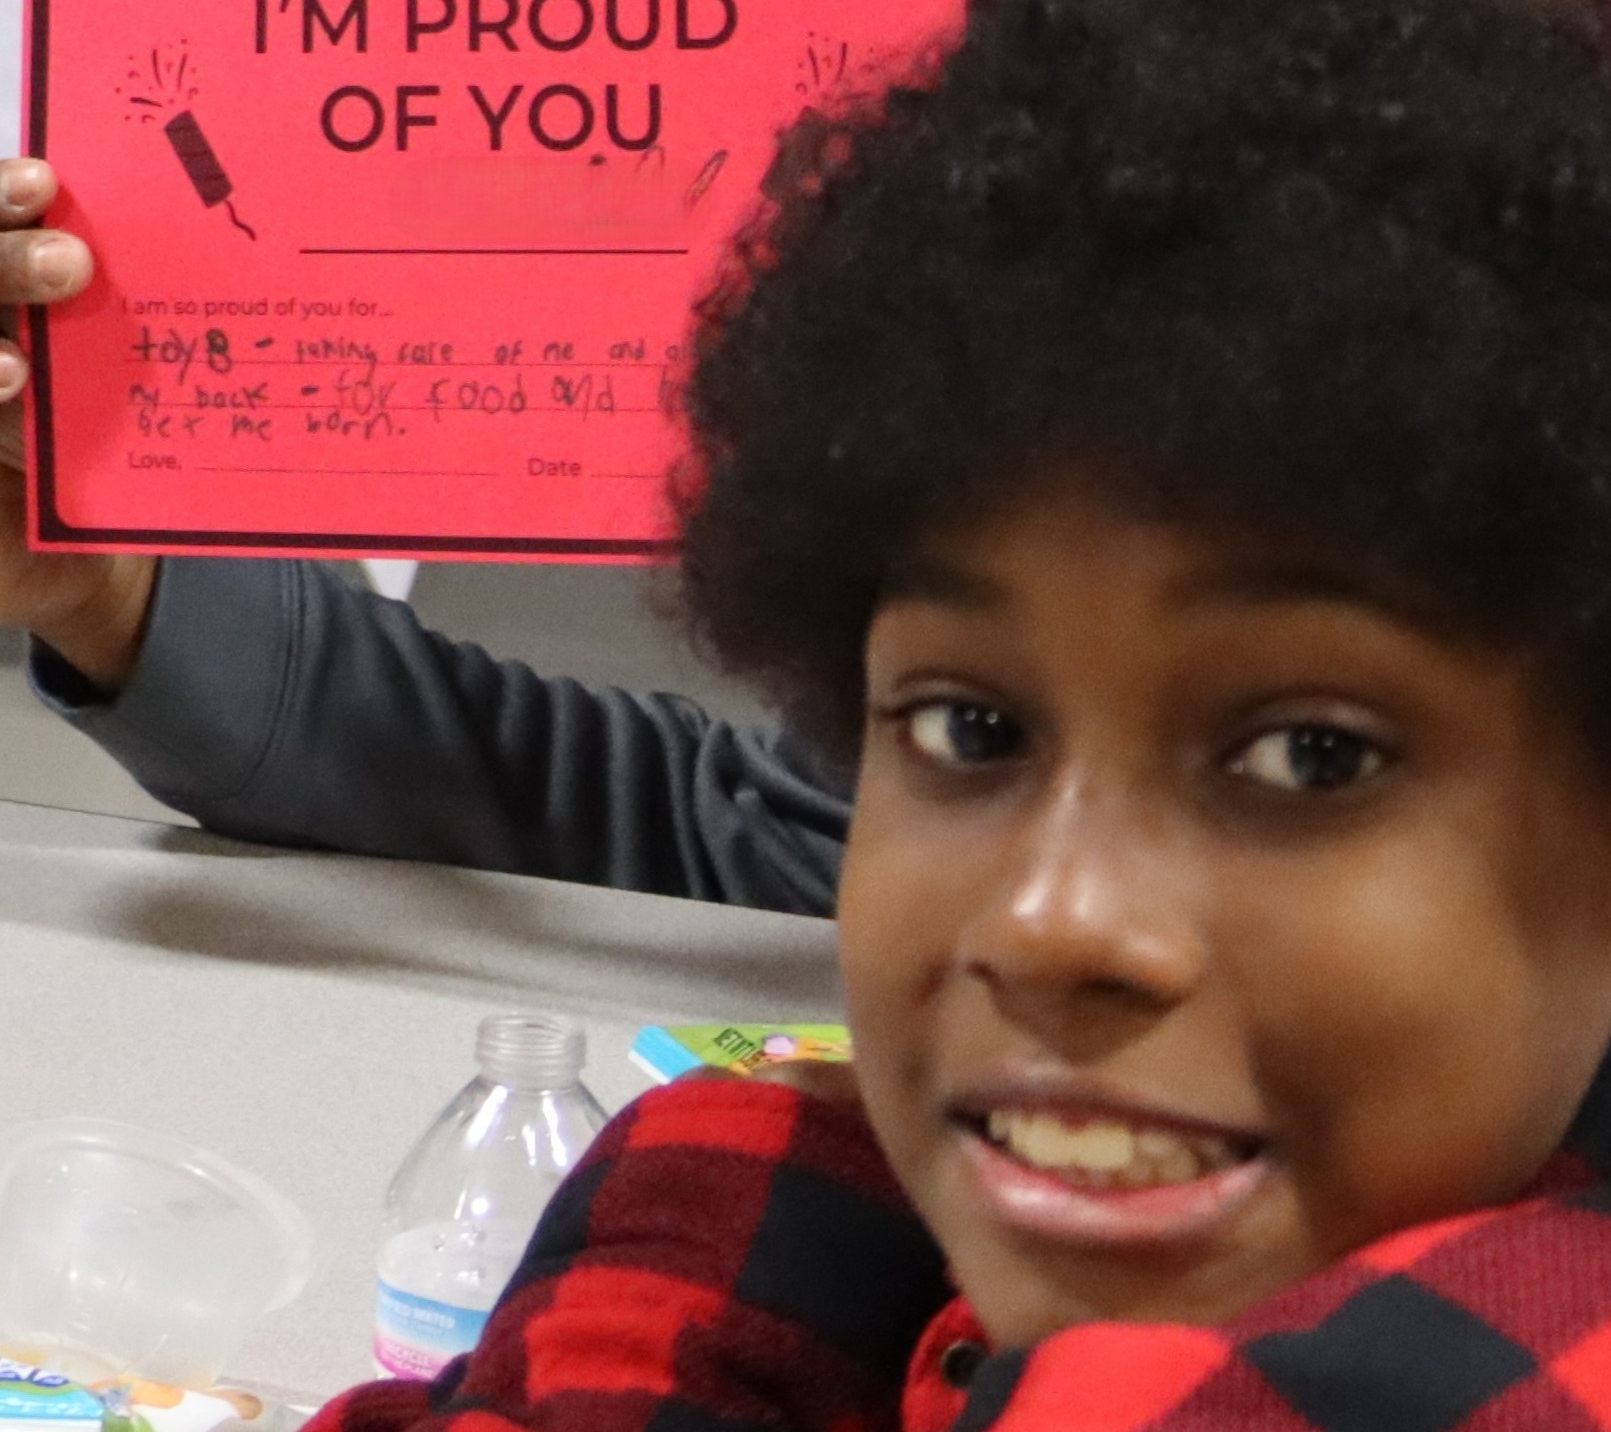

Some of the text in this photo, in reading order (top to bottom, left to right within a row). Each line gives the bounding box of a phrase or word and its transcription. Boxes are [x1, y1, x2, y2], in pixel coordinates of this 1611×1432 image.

[320, 83, 662, 152] OF YOU
[133, 299, 168, 316] am
[175, 299, 198, 316] so
[204, 297, 269, 318] proud
[275, 297, 296, 316] of
[301, 299, 342, 320] you
[194, 381, 269, 410] back
[528, 457, 582, 478] Date
